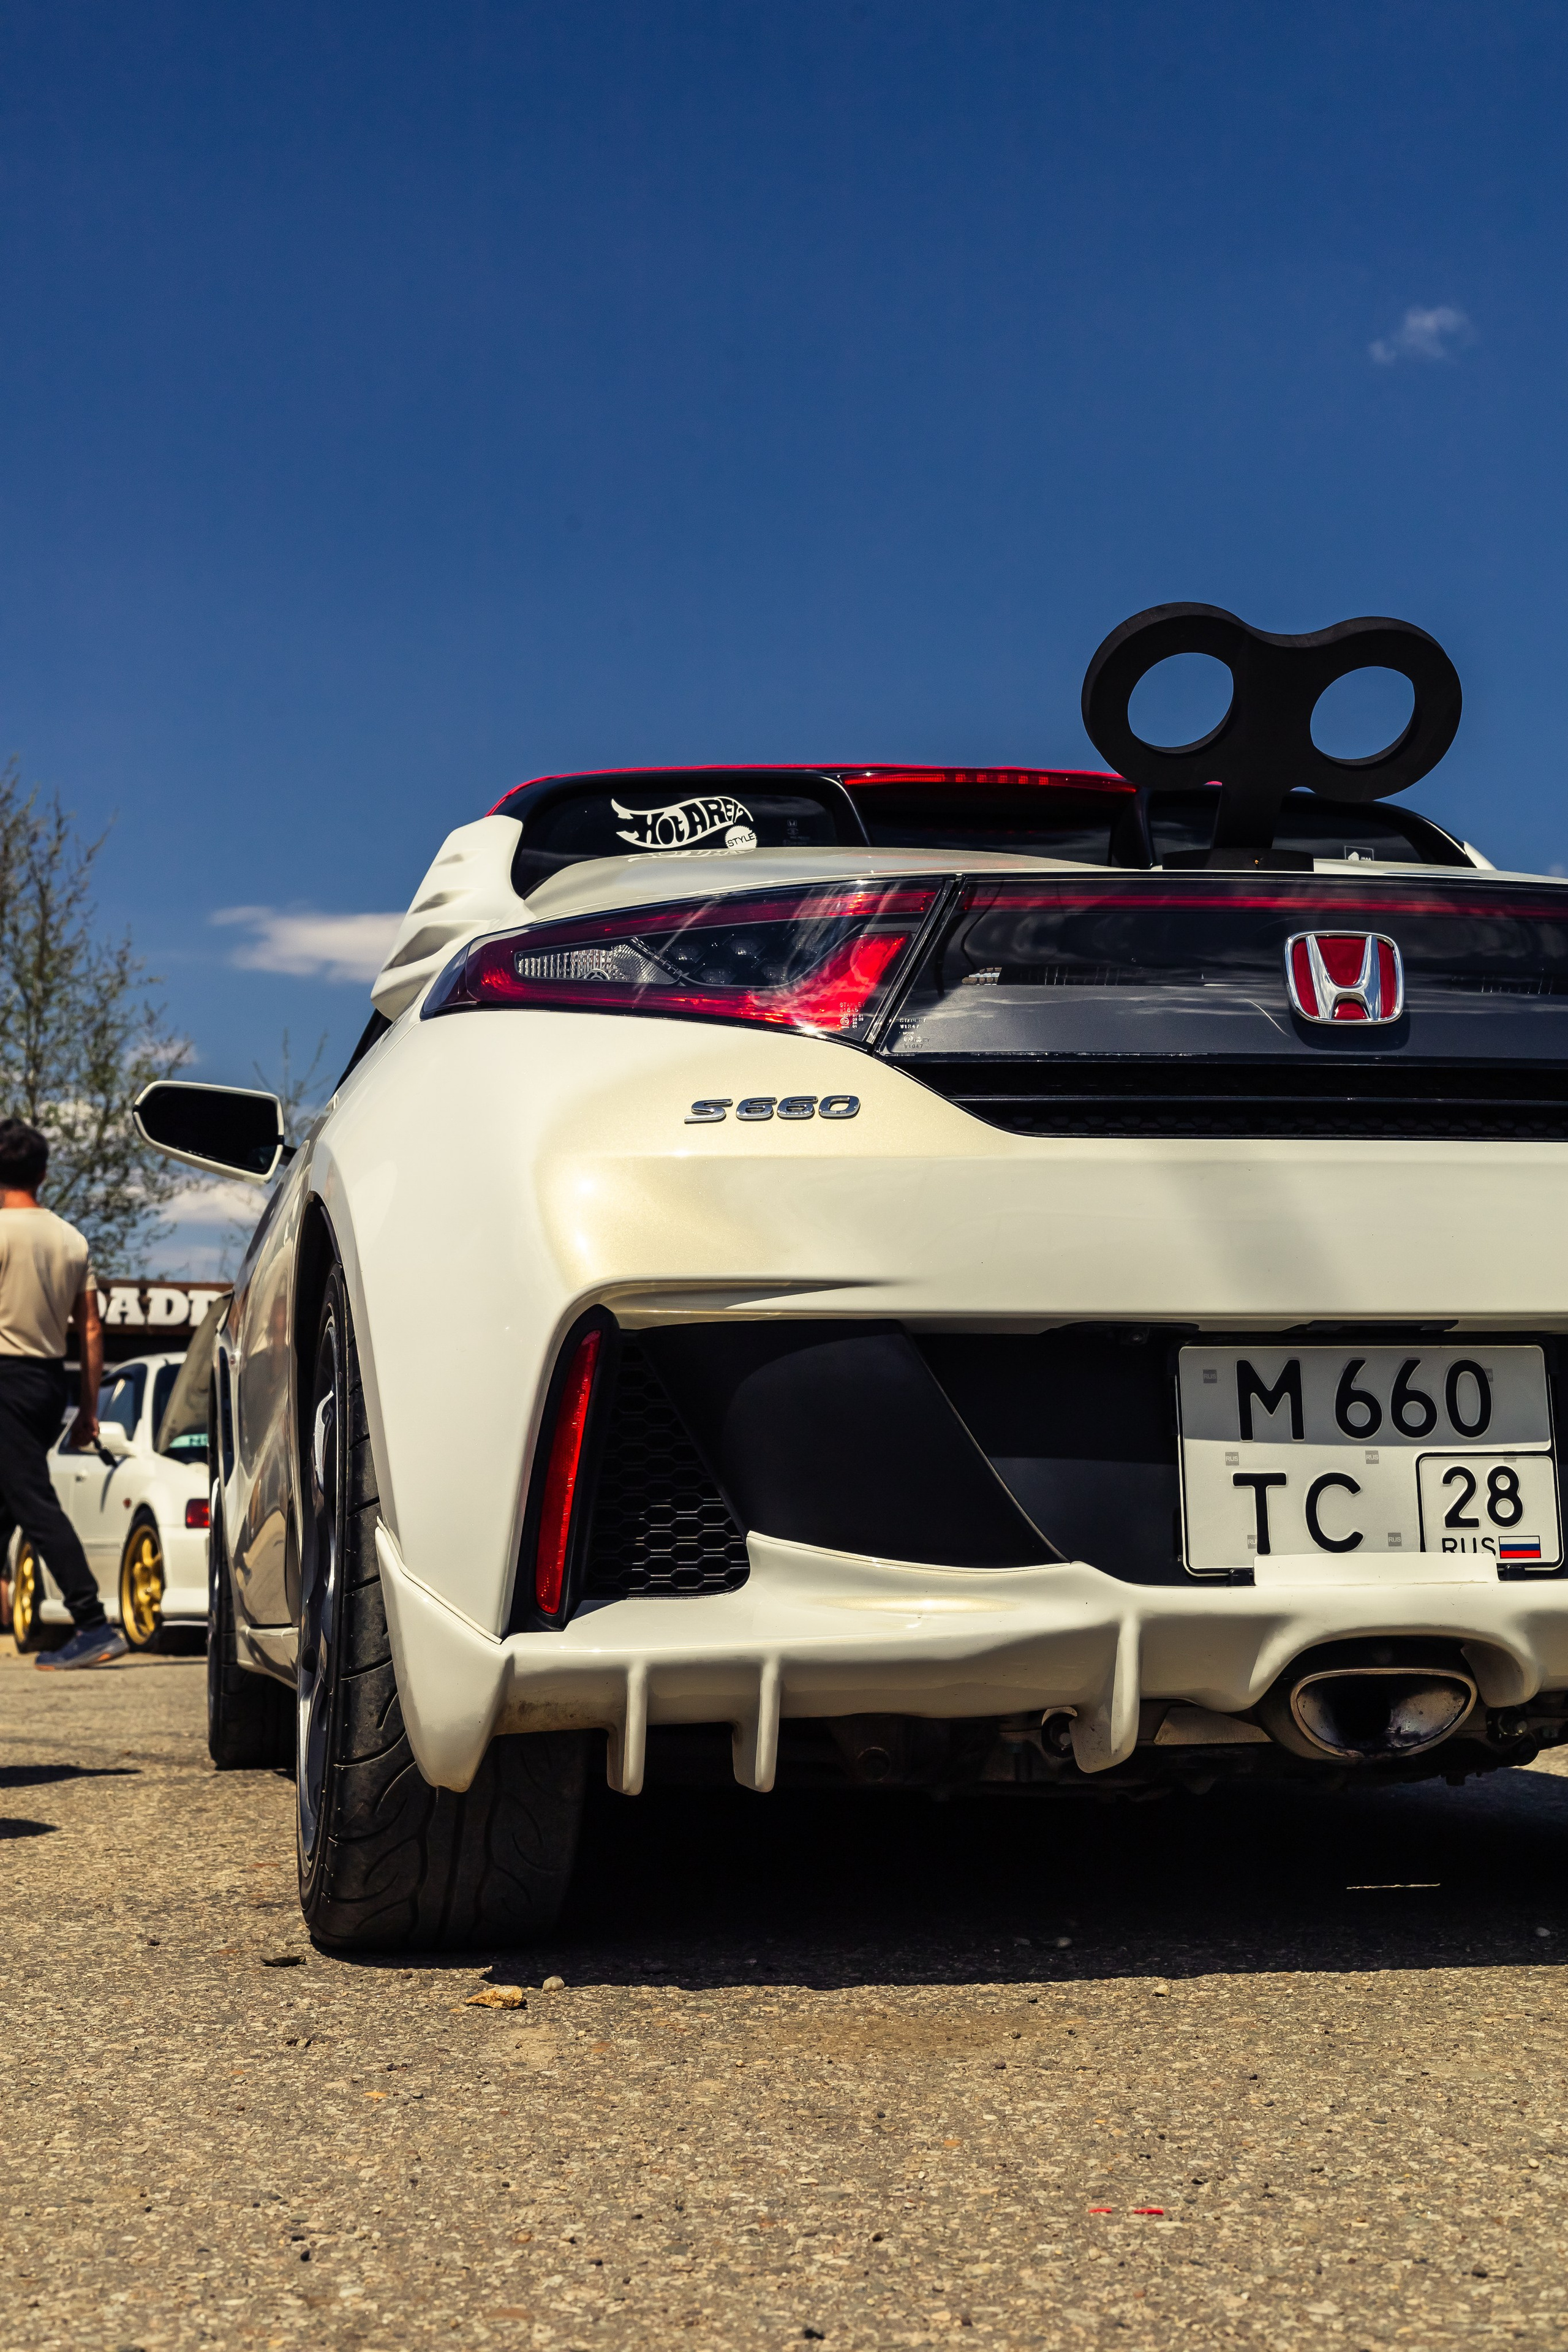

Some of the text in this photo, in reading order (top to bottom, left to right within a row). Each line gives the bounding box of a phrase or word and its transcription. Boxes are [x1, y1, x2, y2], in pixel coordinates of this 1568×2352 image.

[727, 832, 755, 847] STYLE
[684, 1095, 861, 1125] S660
[1236, 1359, 1493, 1441] M 660
[1442, 1465, 1524, 1528] 28
[1441, 1537, 1496, 1556] RUS
